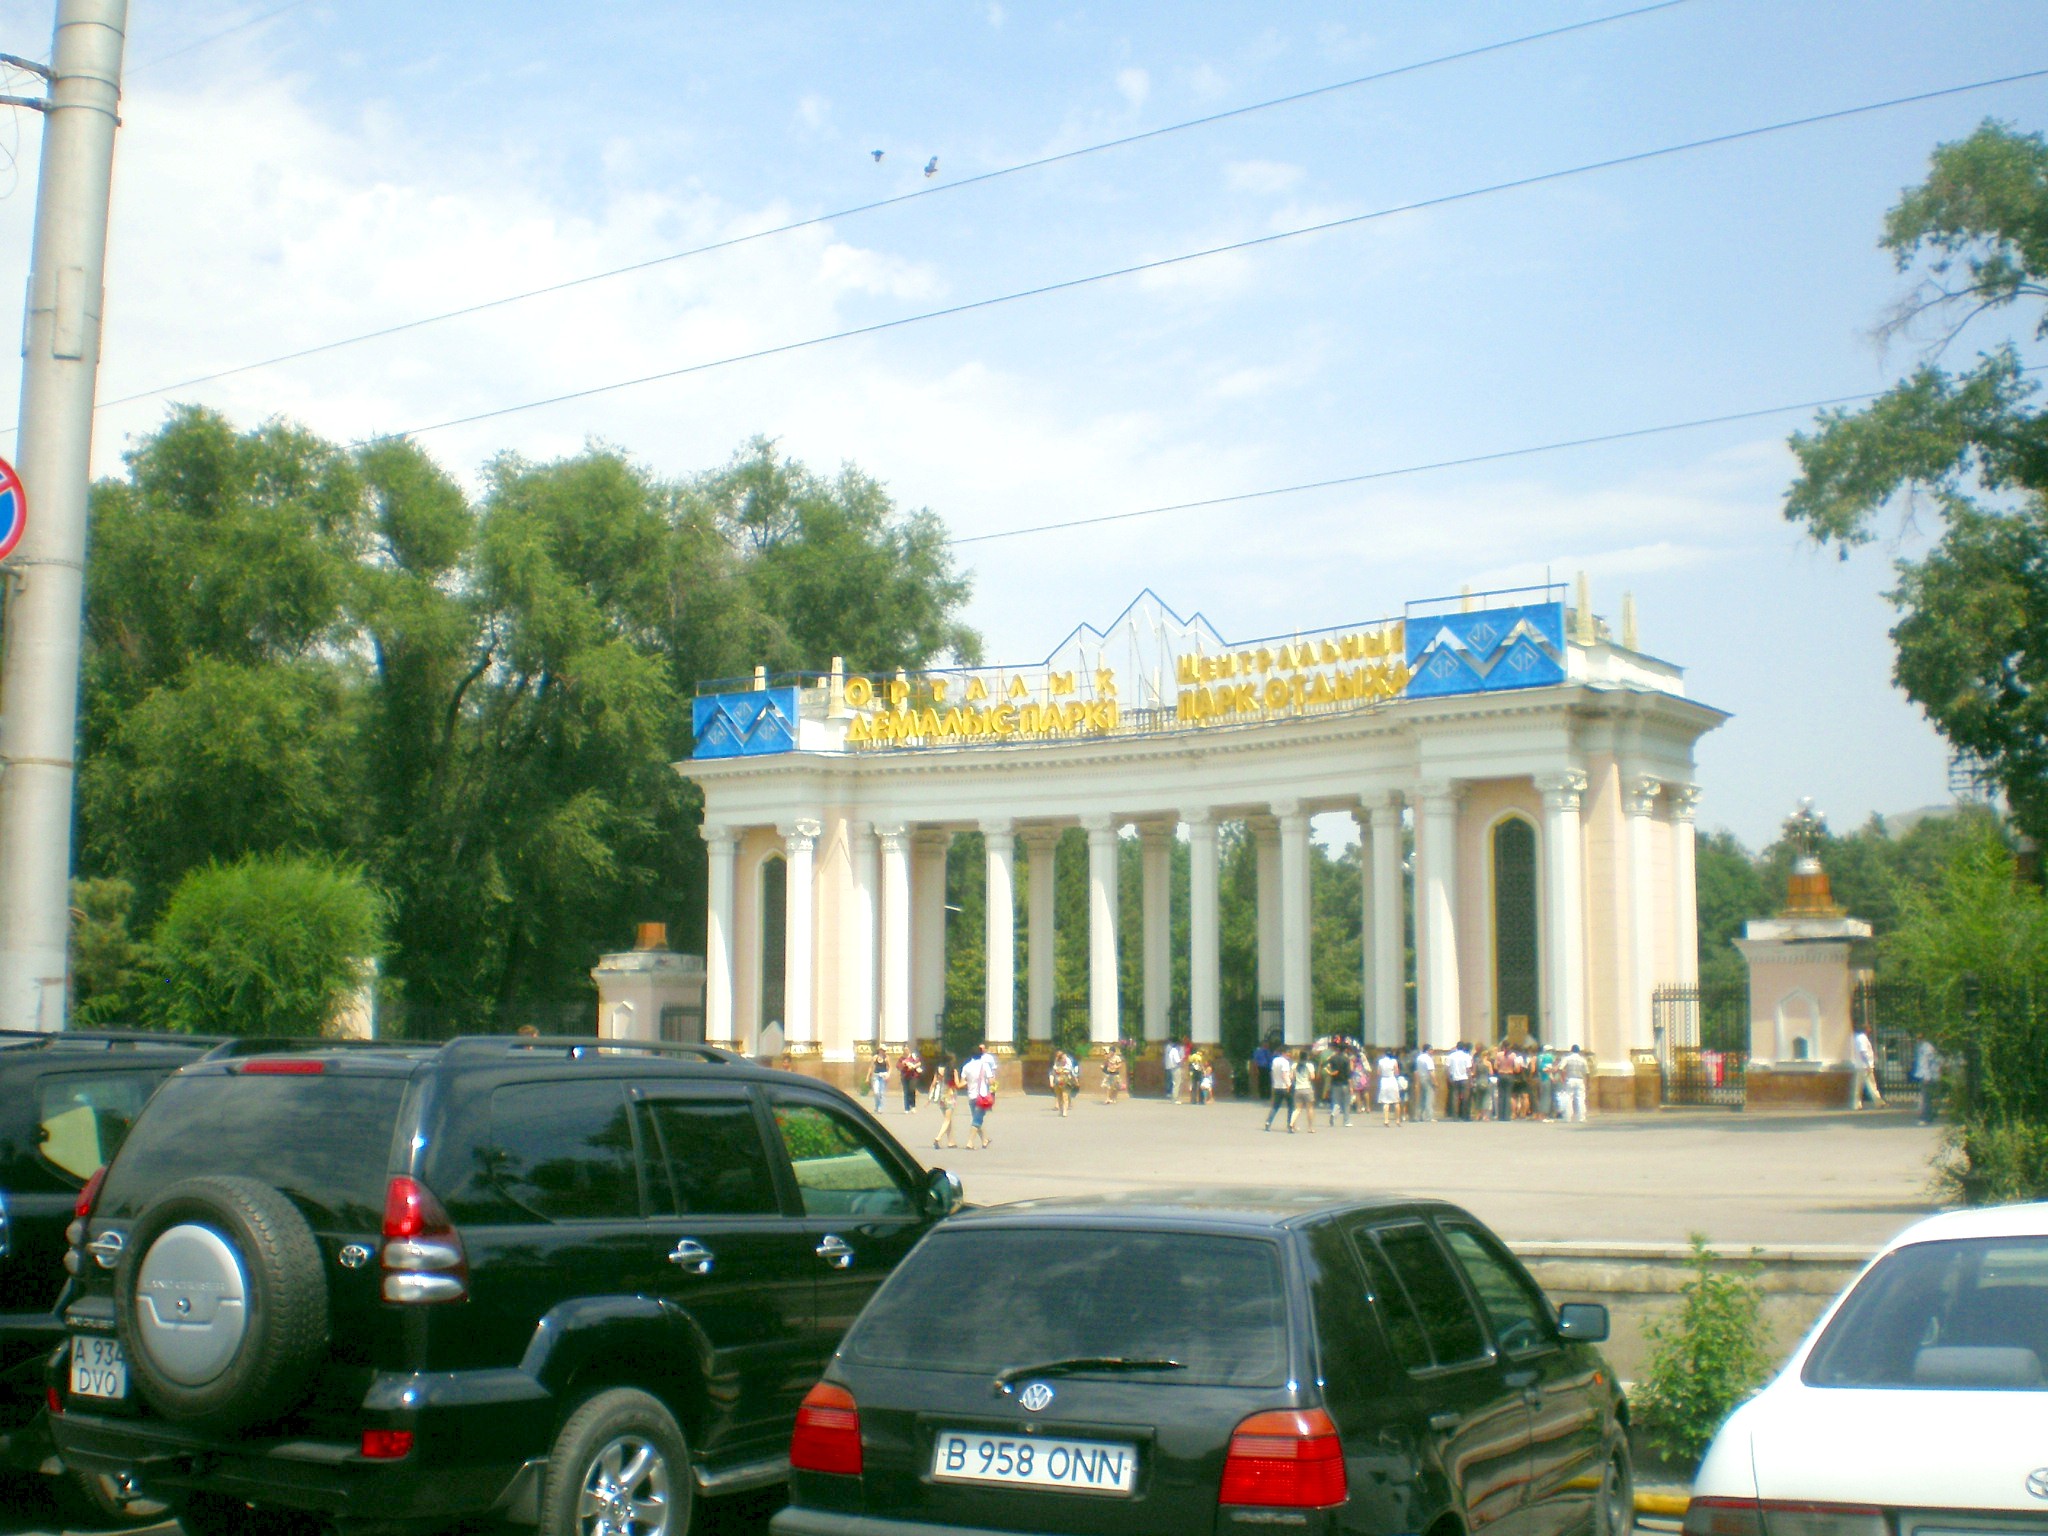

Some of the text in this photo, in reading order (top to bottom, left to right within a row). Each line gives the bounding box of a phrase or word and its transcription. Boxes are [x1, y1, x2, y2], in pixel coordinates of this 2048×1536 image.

[1177, 660, 1413, 721] ПАРК ОТДЫХА
[74, 1340, 86, 1364] A
[79, 1368, 117, 1396] DVO
[945, 1438, 1124, 1485] B 958 ONN
